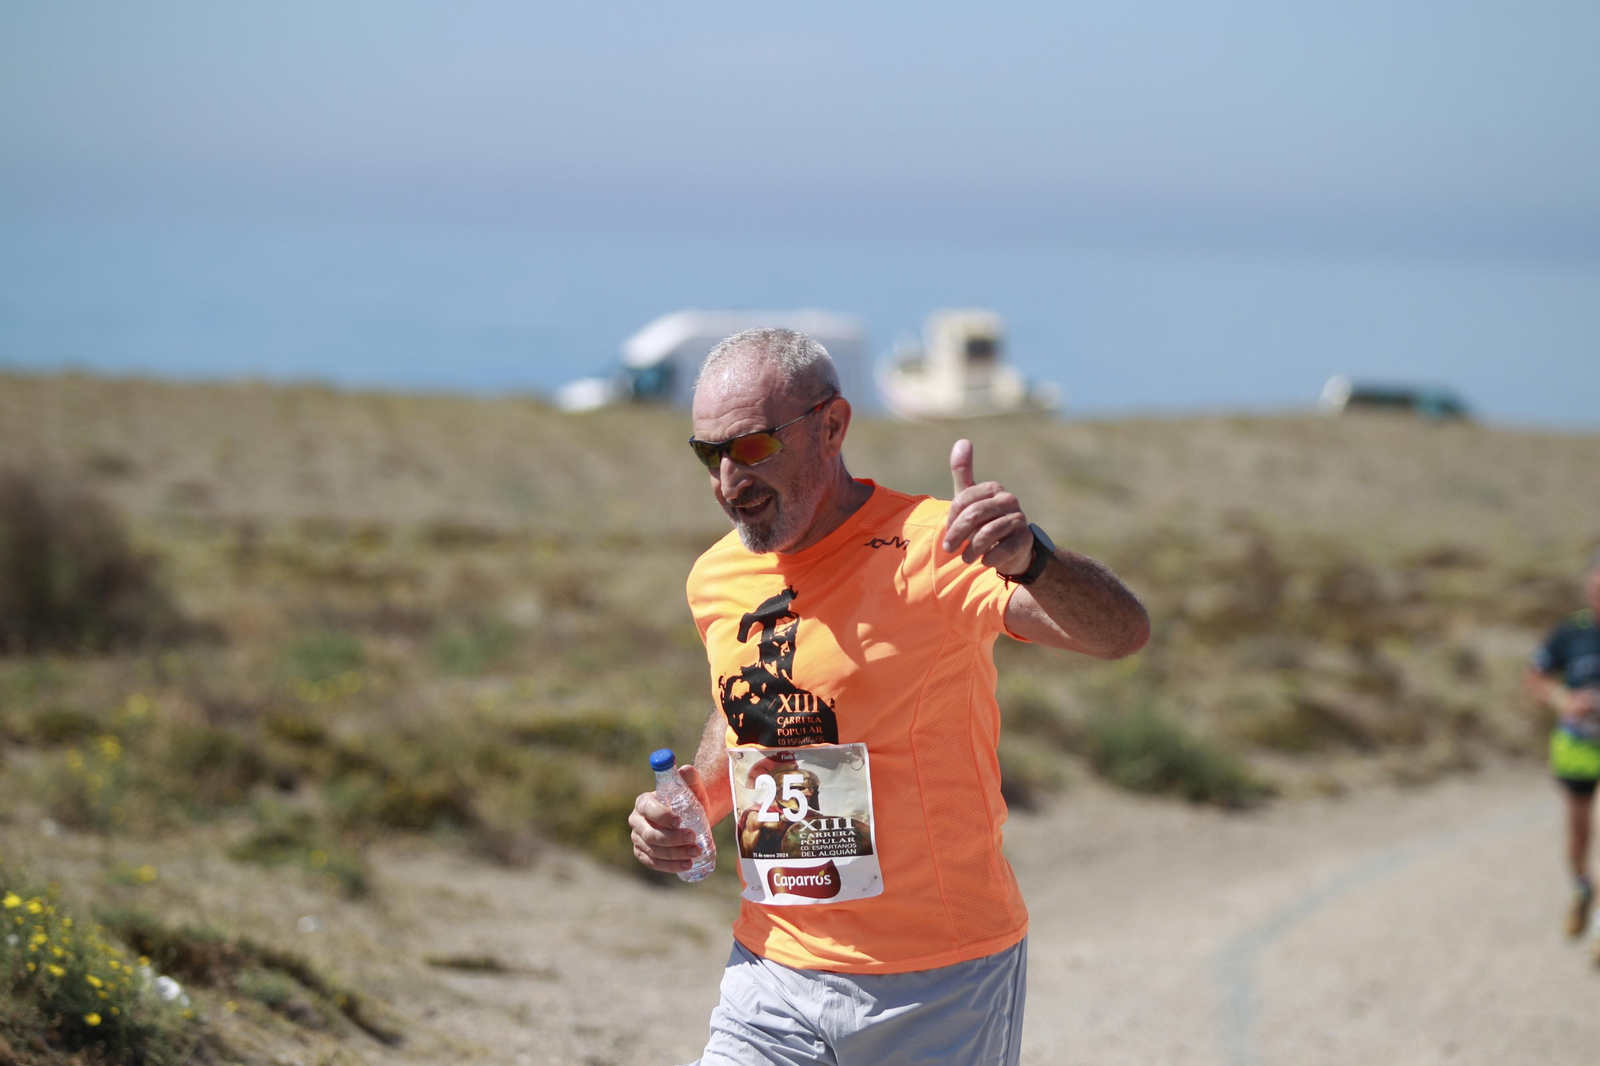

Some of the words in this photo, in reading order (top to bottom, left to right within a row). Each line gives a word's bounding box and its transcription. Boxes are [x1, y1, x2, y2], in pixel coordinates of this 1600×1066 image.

[777, 693, 820, 713] XIII
[755, 774, 808, 822] 25
[799, 816, 855, 832] XIII
[799, 830, 857, 839] CARRERA
[800, 837, 856, 846] POPULAR
[811, 843, 857, 851] ESPARTANOS
